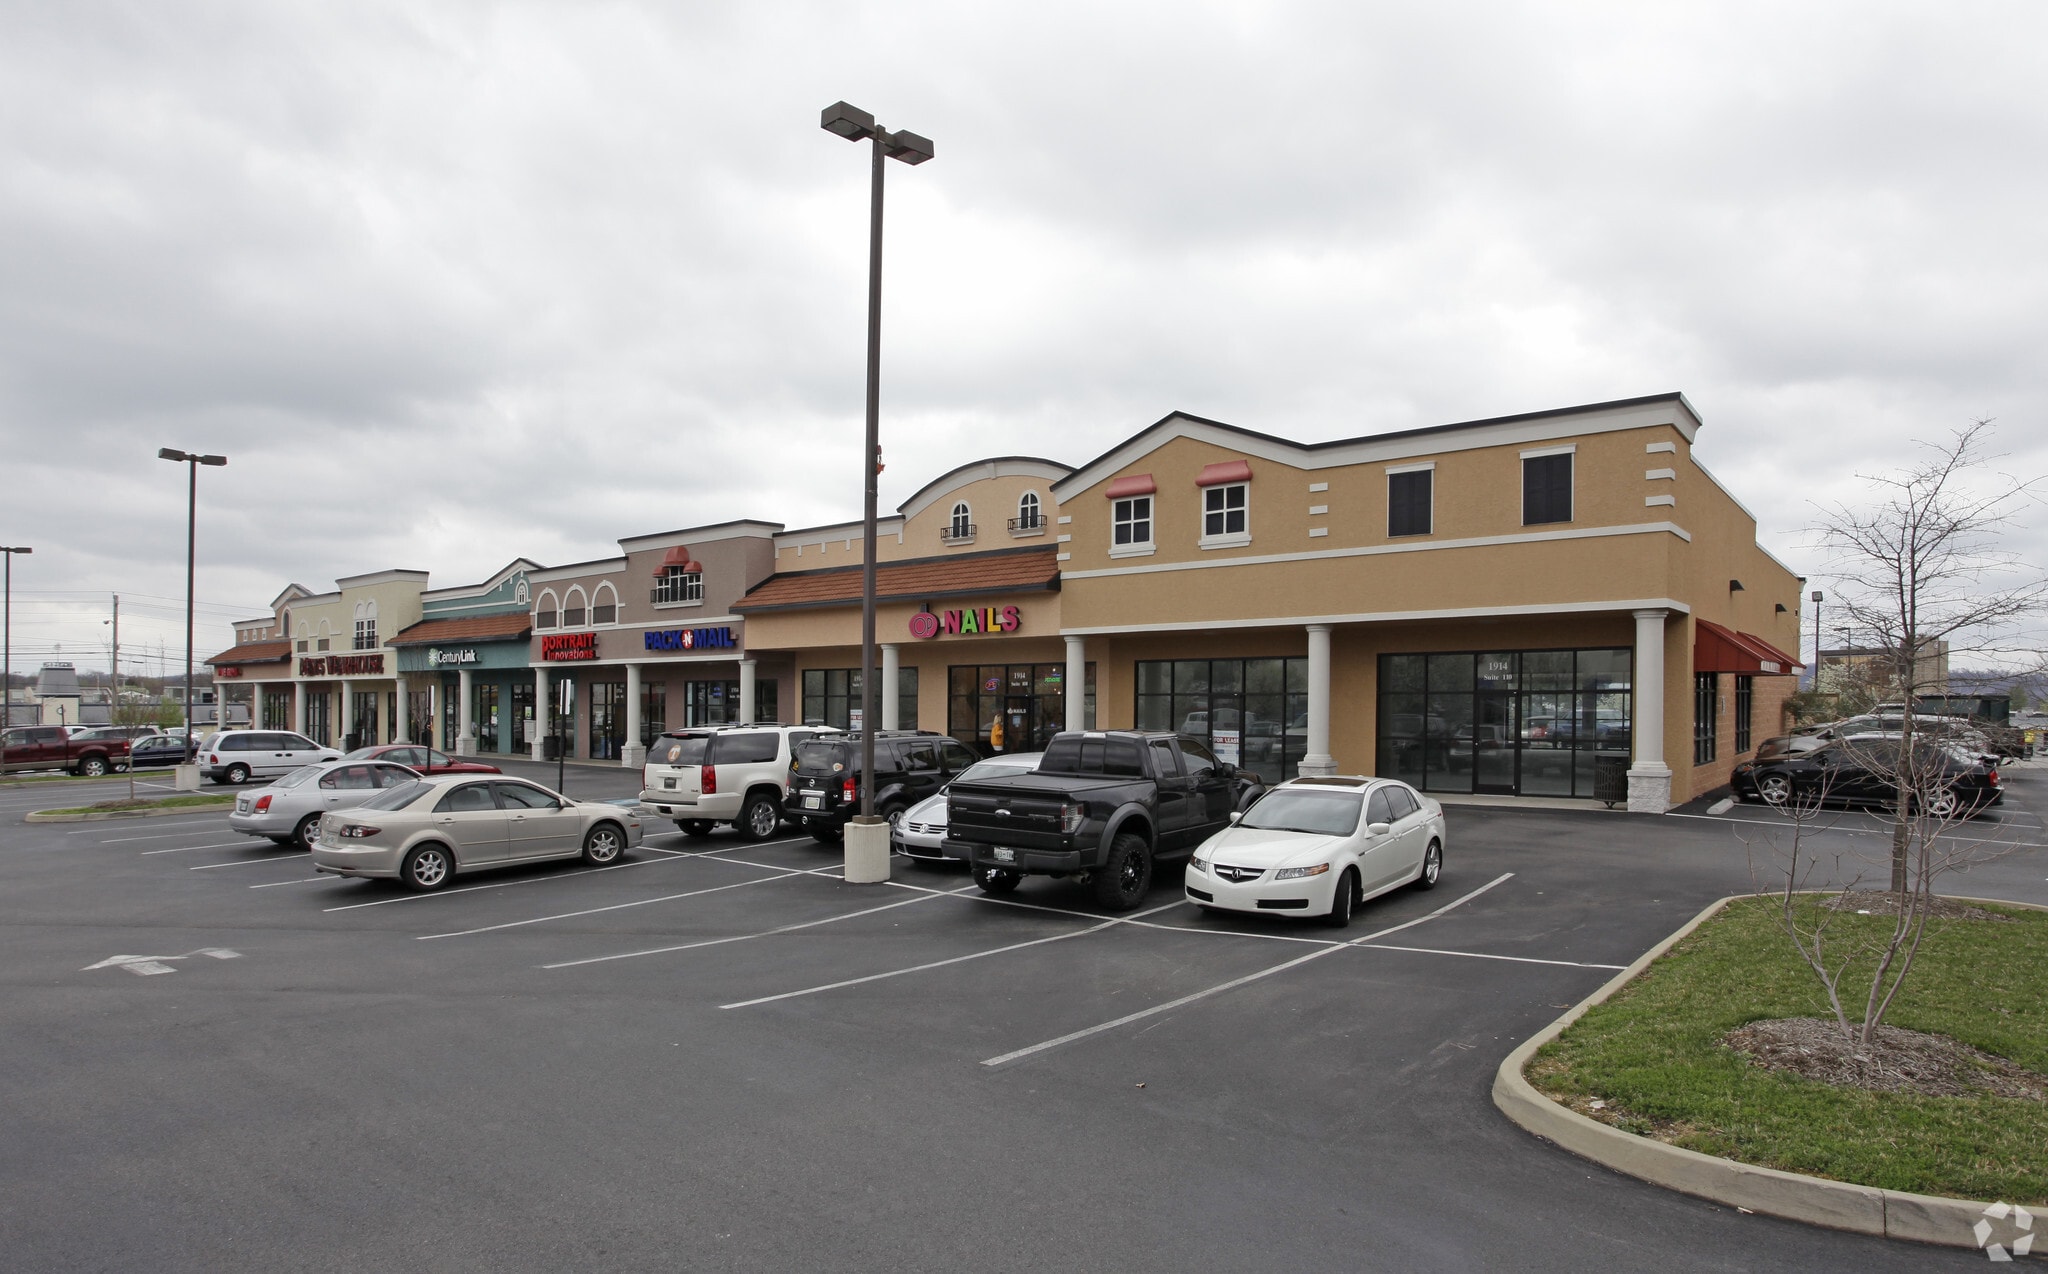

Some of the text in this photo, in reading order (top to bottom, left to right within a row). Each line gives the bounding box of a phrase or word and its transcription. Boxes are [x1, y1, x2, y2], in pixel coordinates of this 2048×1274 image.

[944, 606, 1019, 634] NAILS
[542, 633, 594, 659] PORTRAIT
[645, 630, 682, 650] PACK
[694, 627, 733, 648] MAIL
[437, 649, 476, 665] CenturyLink
[1489, 662, 1508, 671] 1914
[1013, 672, 1026, 680] 1914
